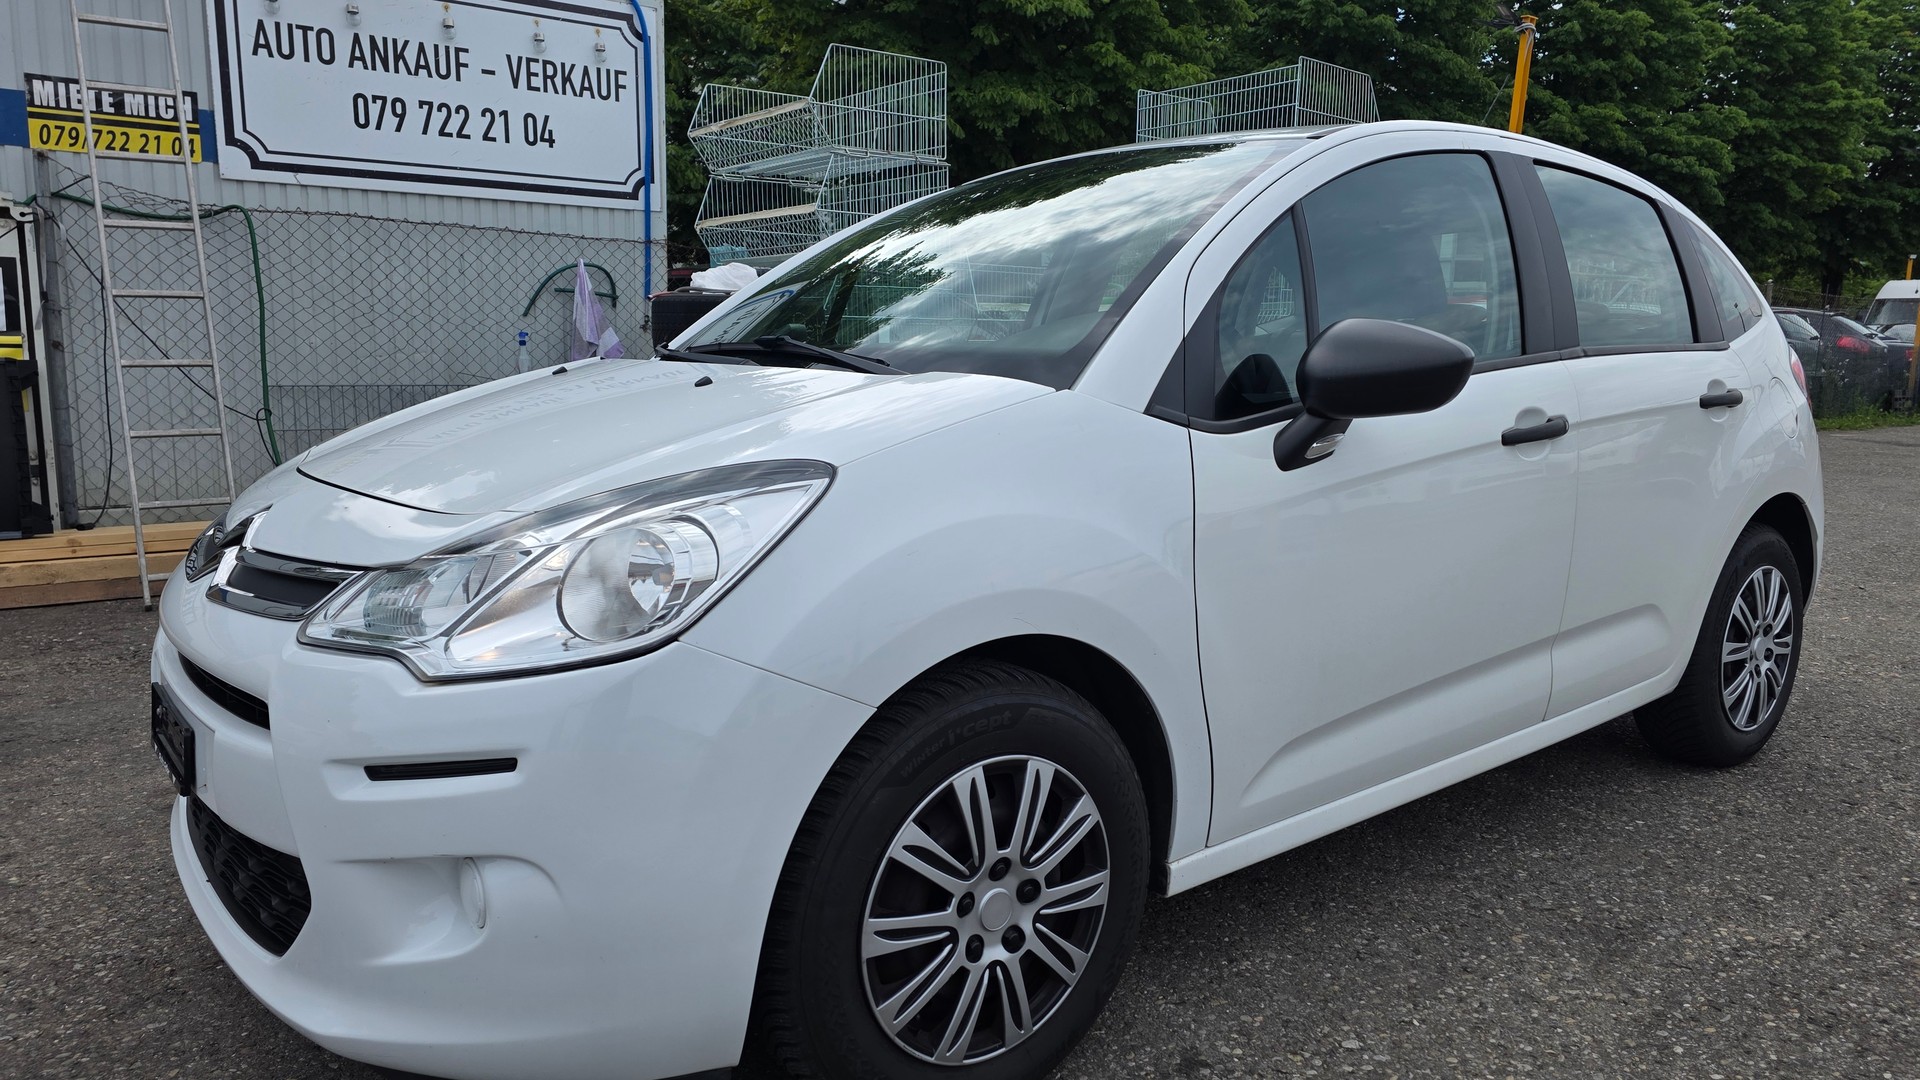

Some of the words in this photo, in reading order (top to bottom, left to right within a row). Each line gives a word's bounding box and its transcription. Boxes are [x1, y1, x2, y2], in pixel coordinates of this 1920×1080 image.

[252, 18, 336, 66] AUTO
[348, 32, 470, 82] ANKAUF
[505, 53, 628, 102] VERKAUF
[32, 79, 115, 114] MIETE
[123, 92, 193, 122] MICH
[352, 92, 407, 133] 079
[418, 99, 471, 140] 722
[481, 107, 510, 144] 21
[523, 112, 556, 149] 04
[138, 133, 161, 155] 21
[171, 136, 196, 158] 04
